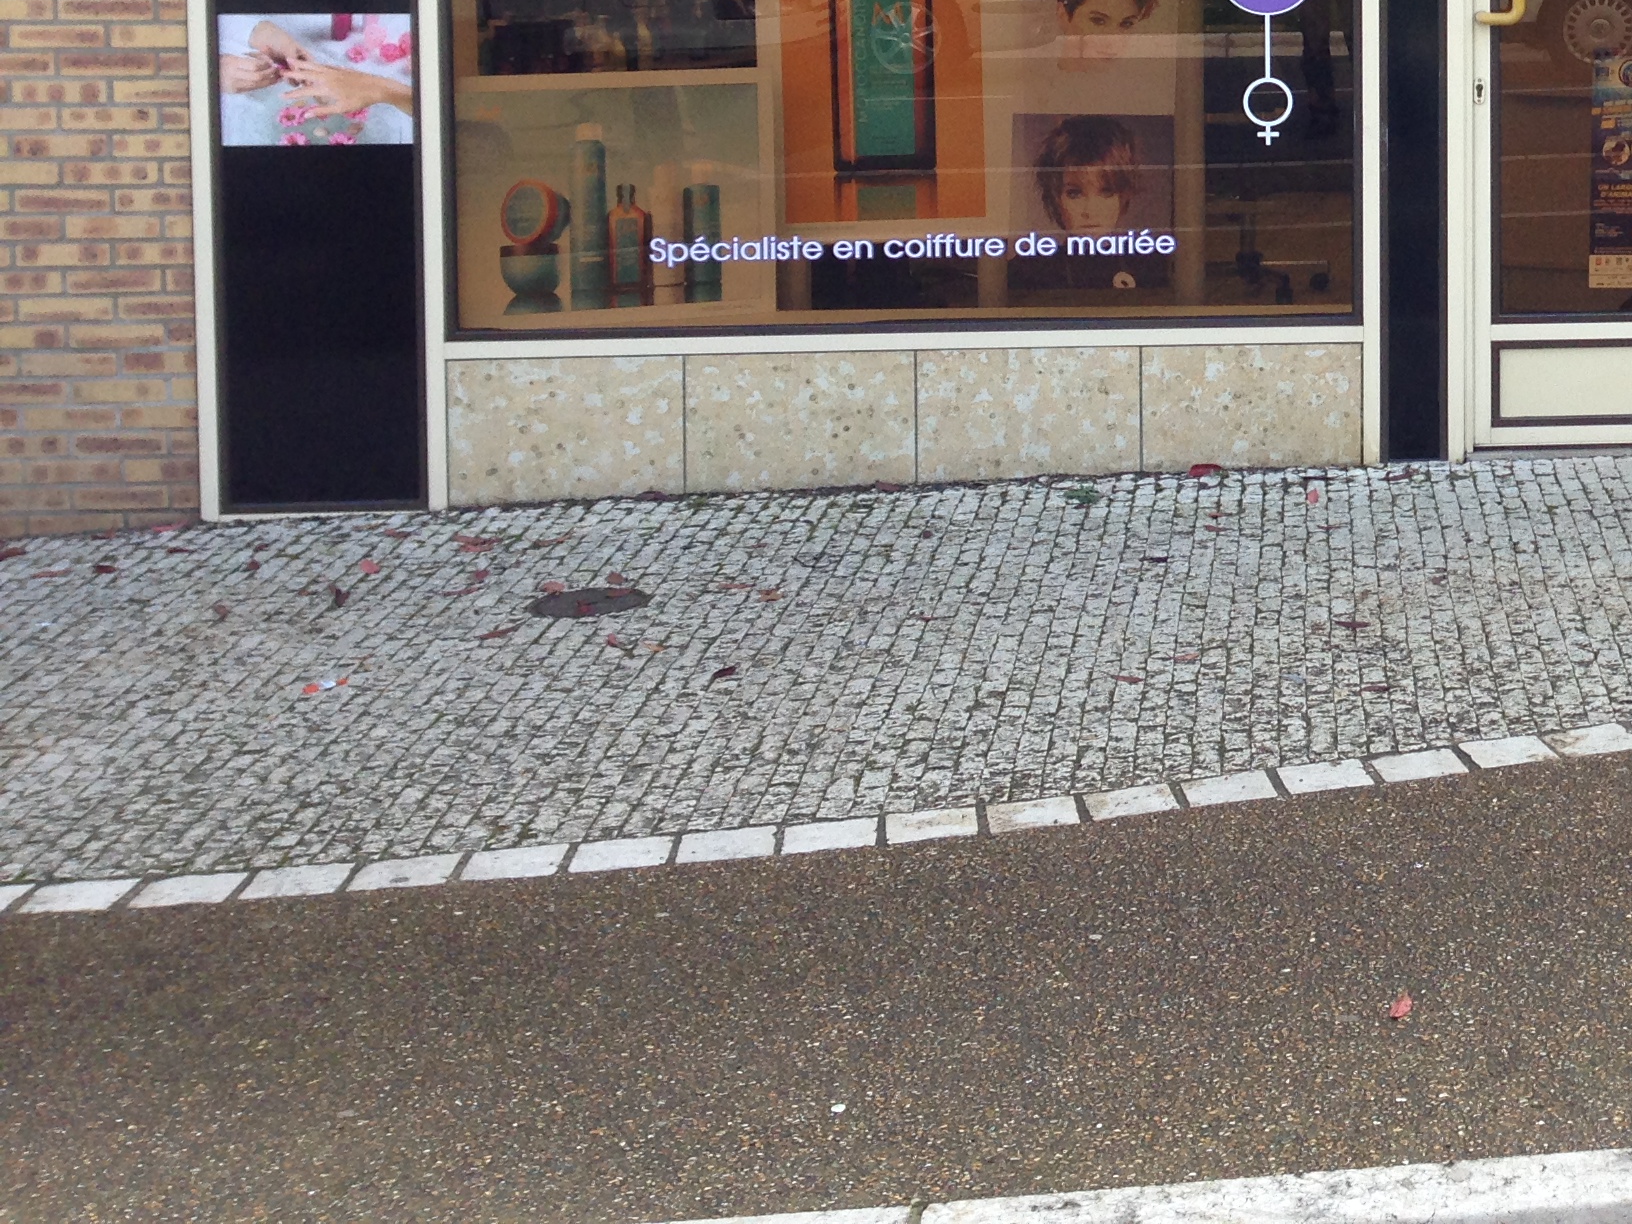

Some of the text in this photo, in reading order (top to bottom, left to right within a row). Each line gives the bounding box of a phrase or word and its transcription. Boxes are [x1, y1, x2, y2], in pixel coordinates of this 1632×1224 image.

[649, 228, 1176, 268] Spécialiste en coiffure de mariée
